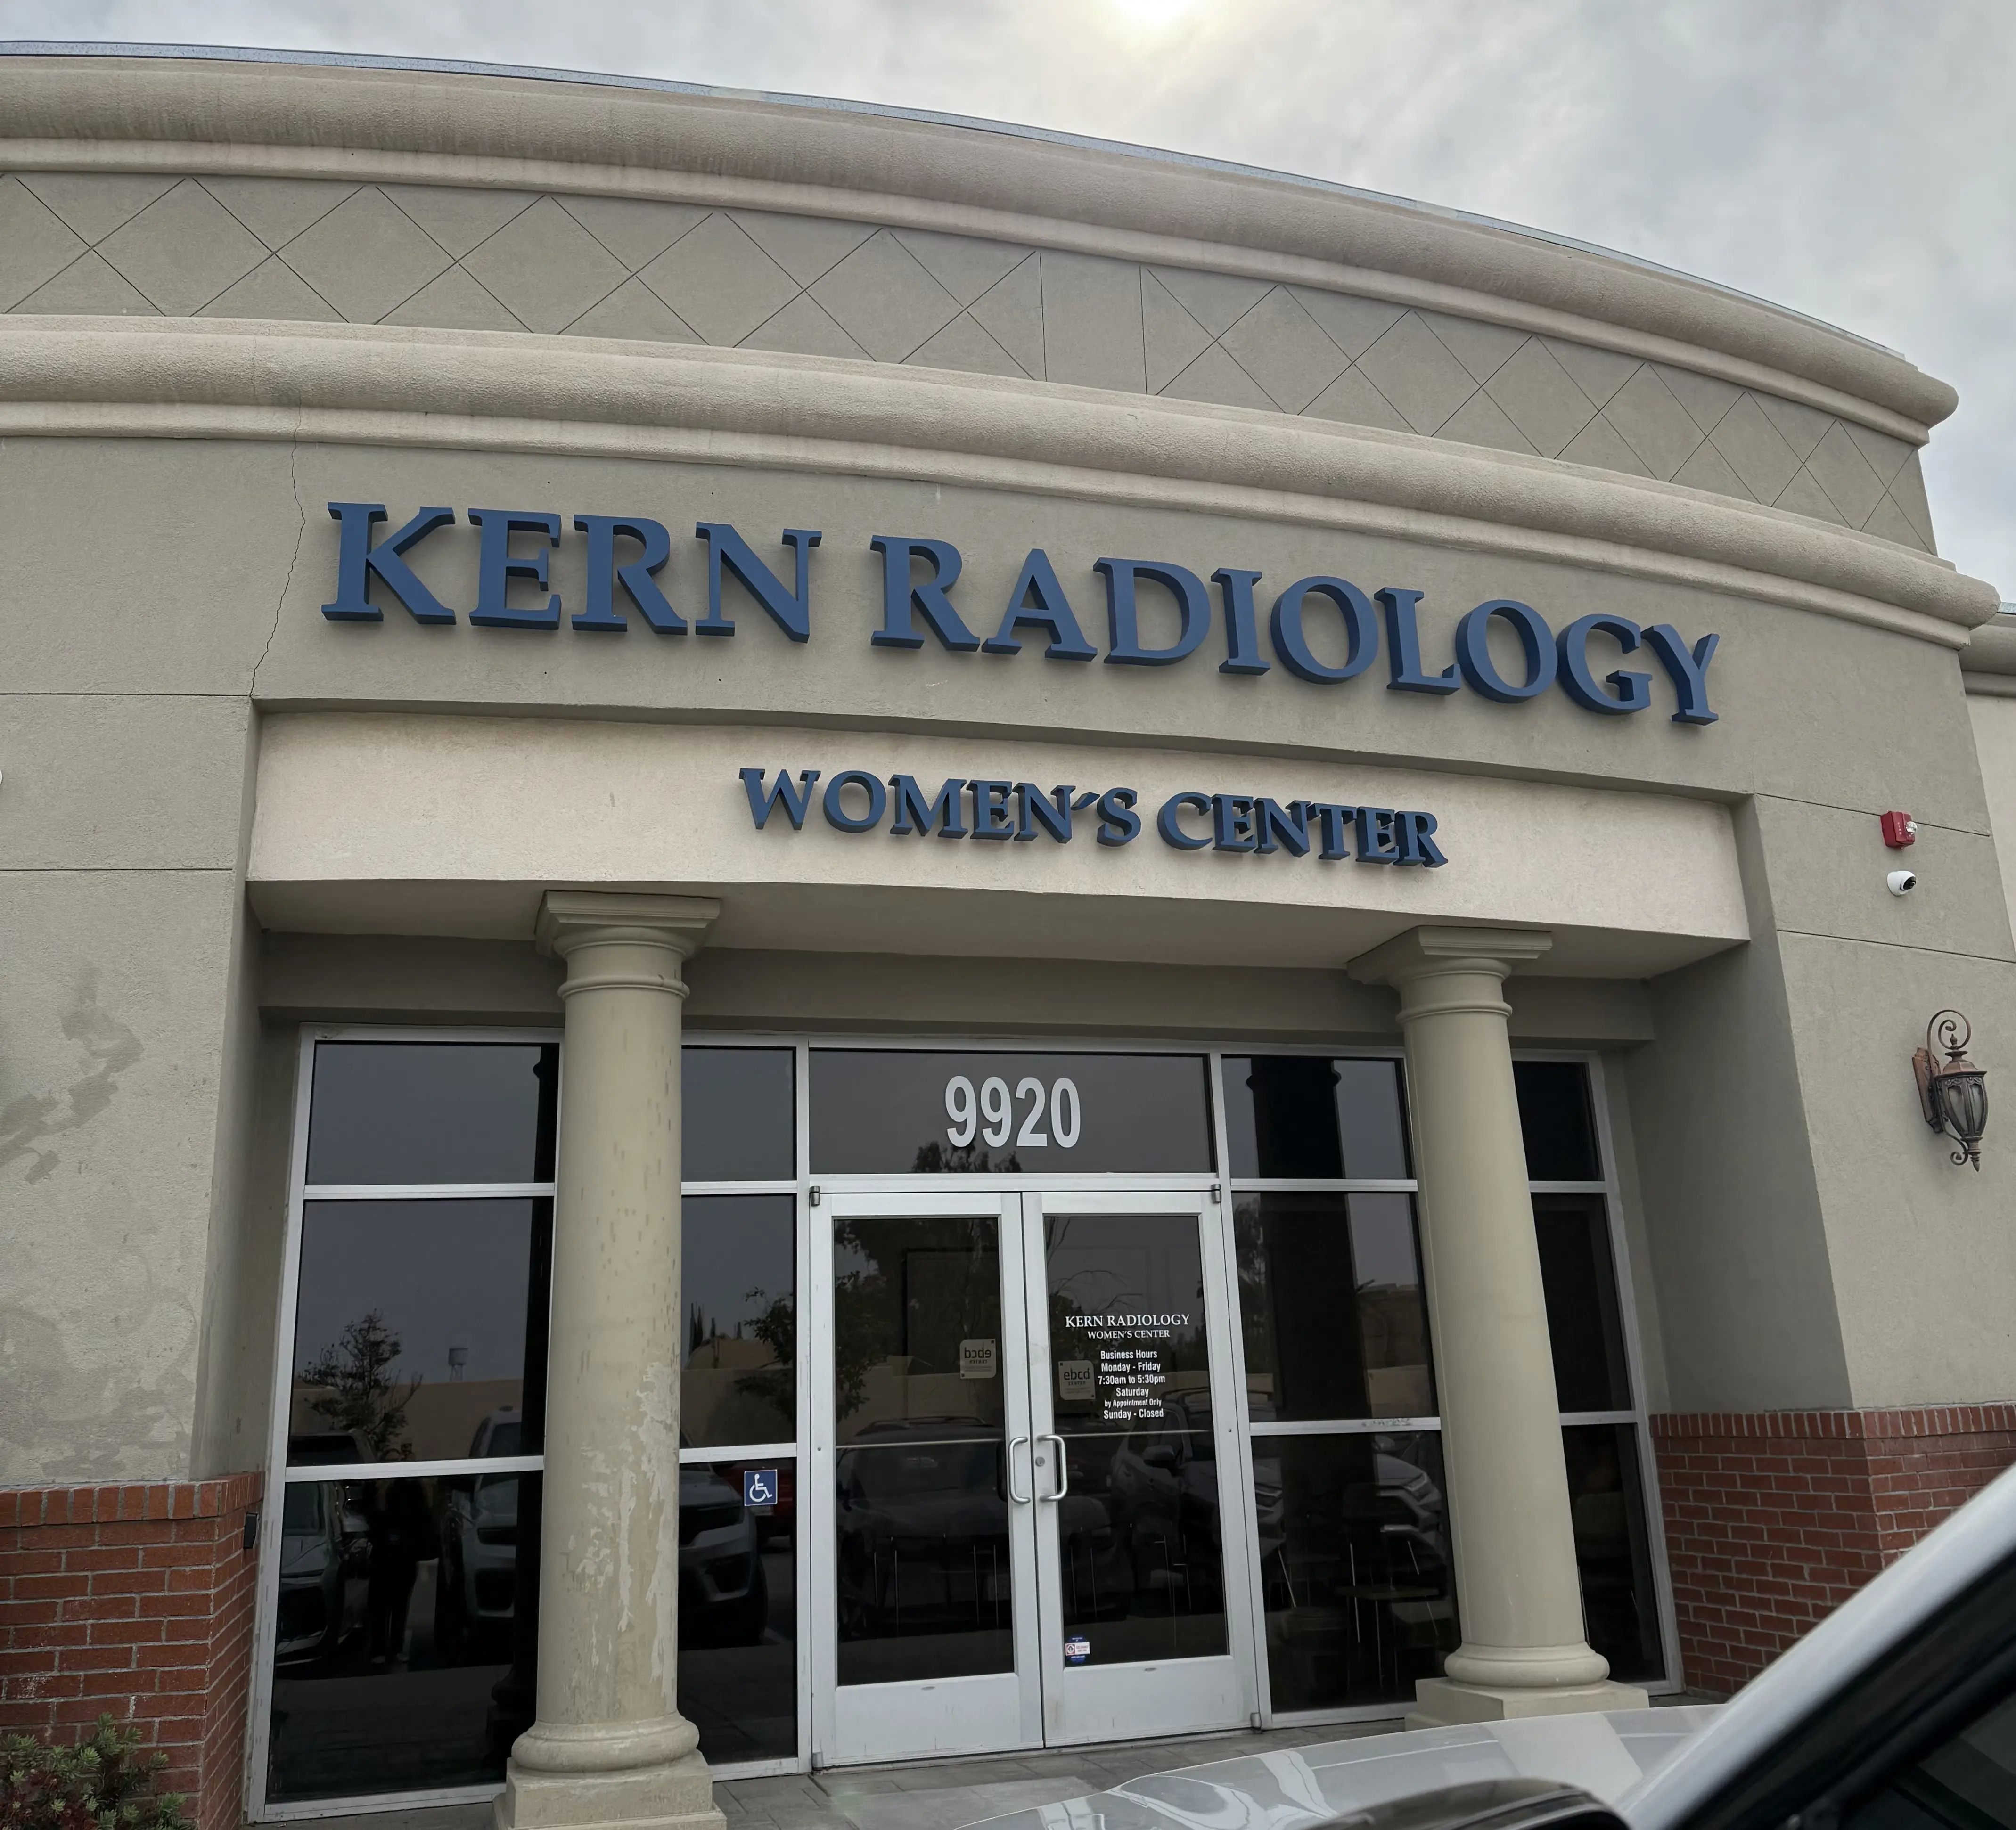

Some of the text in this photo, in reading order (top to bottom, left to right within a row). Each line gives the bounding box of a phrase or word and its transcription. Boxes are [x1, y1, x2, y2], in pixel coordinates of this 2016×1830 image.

[321, 502, 1720, 726] KERN RADIOLOGY
[738, 768, 1450, 869] WOMEN'S CENTER
[945, 1075, 1081, 1148] 9920
[1065, 1314, 1190, 1327] KERN RADIOLOGY
[1087, 1330, 1170, 1339] WOMEN'S CENTER
[1100, 1349, 1157, 1359] Business Hours
[1101, 1363, 1131, 1373] Monday
[1138, 1362, 1161, 1372] Friday
[1098, 1374, 1165, 1385] 7:30am to 5:30pm
[1116, 1387, 1149, 1397] Saturday
[1104, 1398, 1162, 1408] by Appointment Only
[1104, 1409, 1131, 1420] Sunday
[1139, 1408, 1164, 1418] Closed
